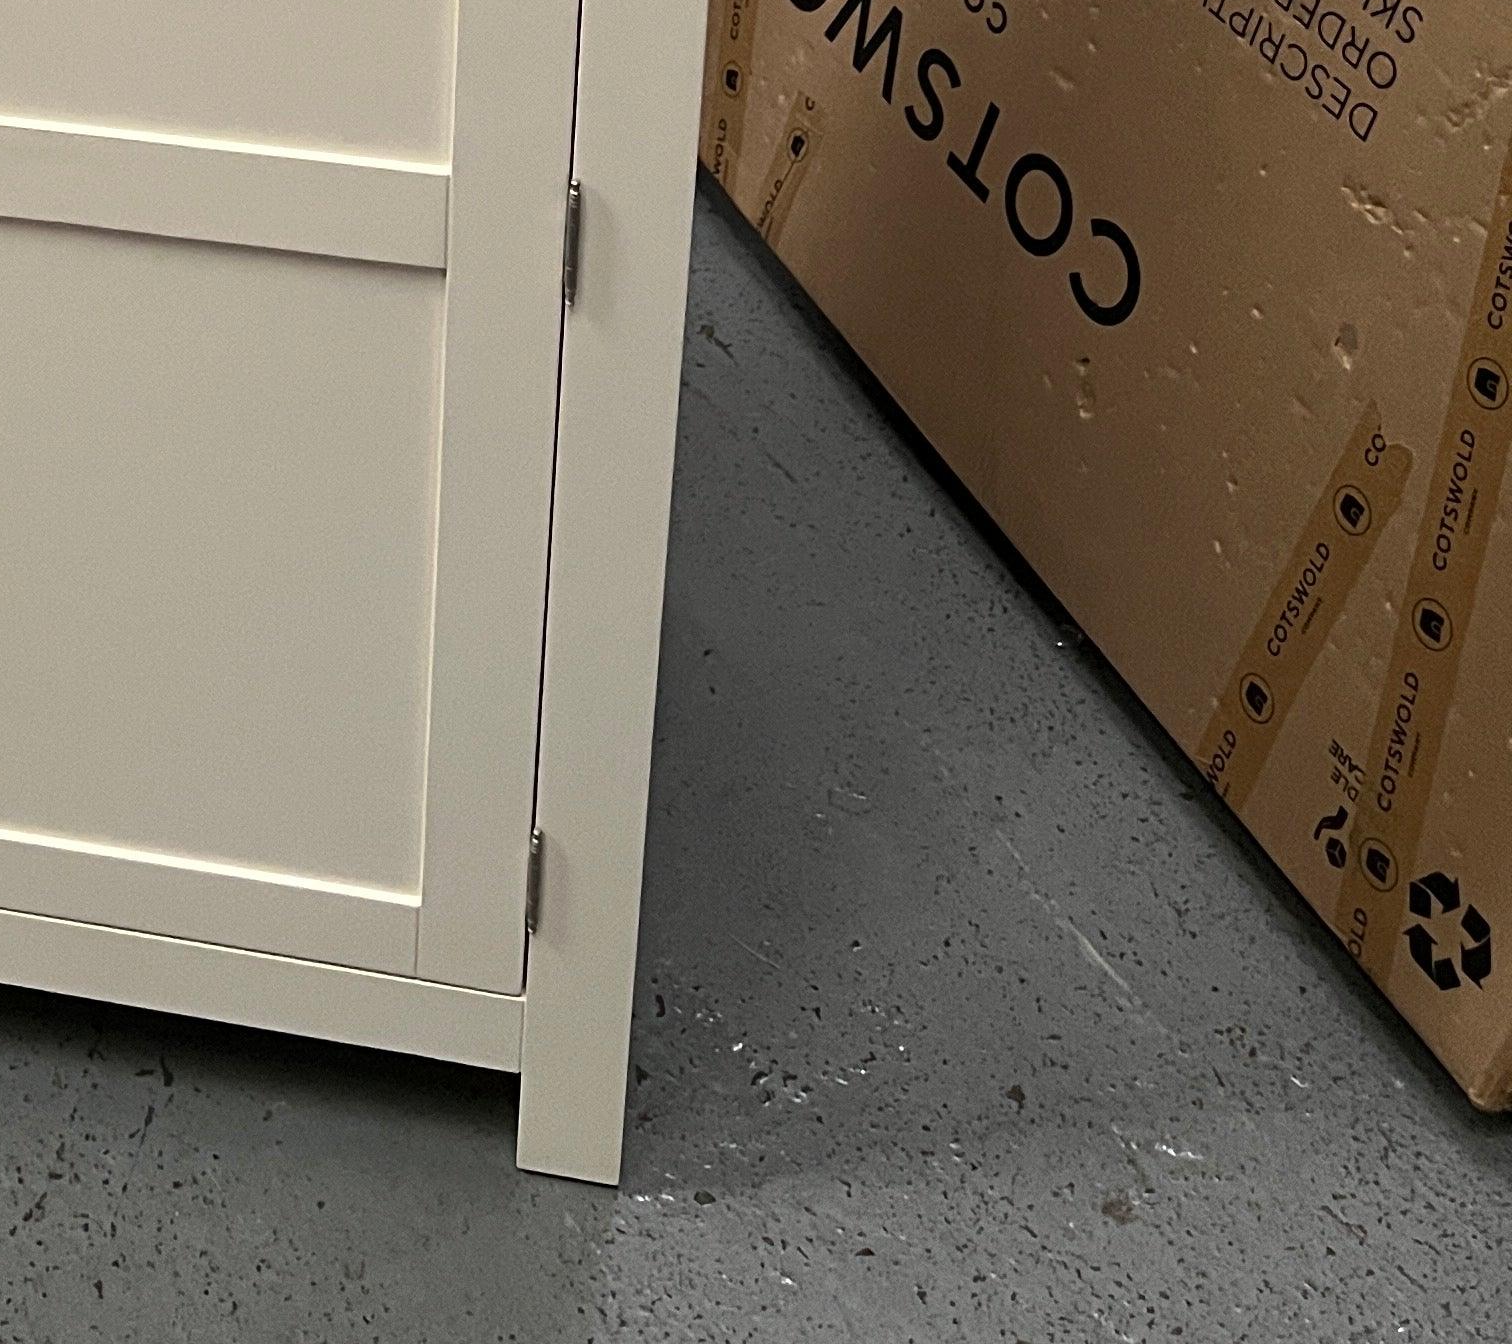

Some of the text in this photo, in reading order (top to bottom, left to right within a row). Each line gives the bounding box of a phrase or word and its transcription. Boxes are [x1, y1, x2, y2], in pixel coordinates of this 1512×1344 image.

[1431, 428, 1477, 572] COTSWOLD
[1267, 541, 1331, 658] COTSWOLD
[1376, 671, 1420, 813] COTSWOLD
